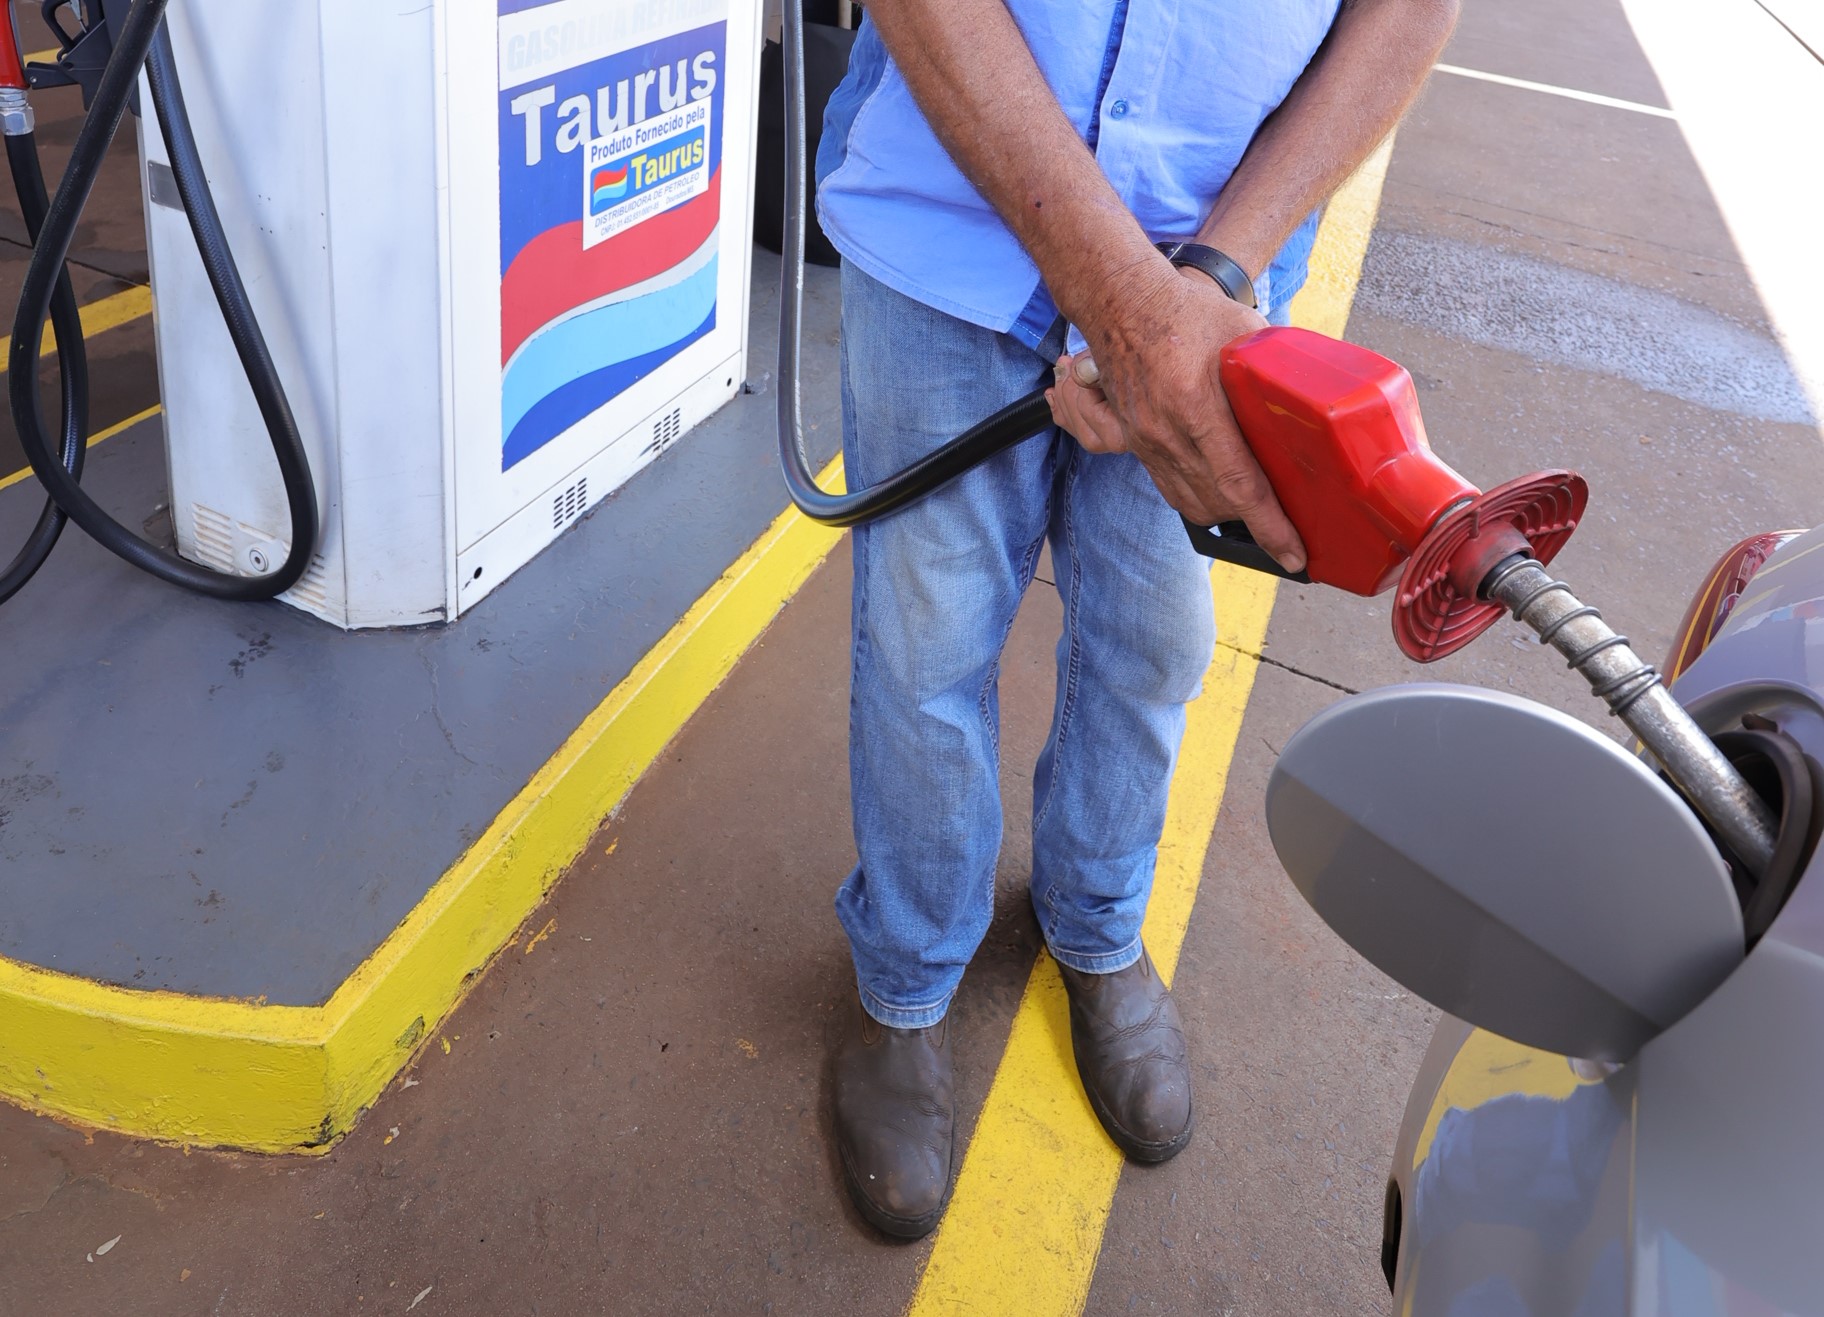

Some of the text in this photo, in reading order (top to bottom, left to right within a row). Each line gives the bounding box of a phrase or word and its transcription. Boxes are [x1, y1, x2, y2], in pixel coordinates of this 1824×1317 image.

[507, 7, 627, 71] GASOLINA
[511, 50, 717, 167] Taurus
[591, 105, 705, 163] Produto Fornecido pela
[631, 138, 704, 190] Taurus
[594, 193, 652, 228] DISTRIBUIDORA
[653, 188, 664, 200] DE
